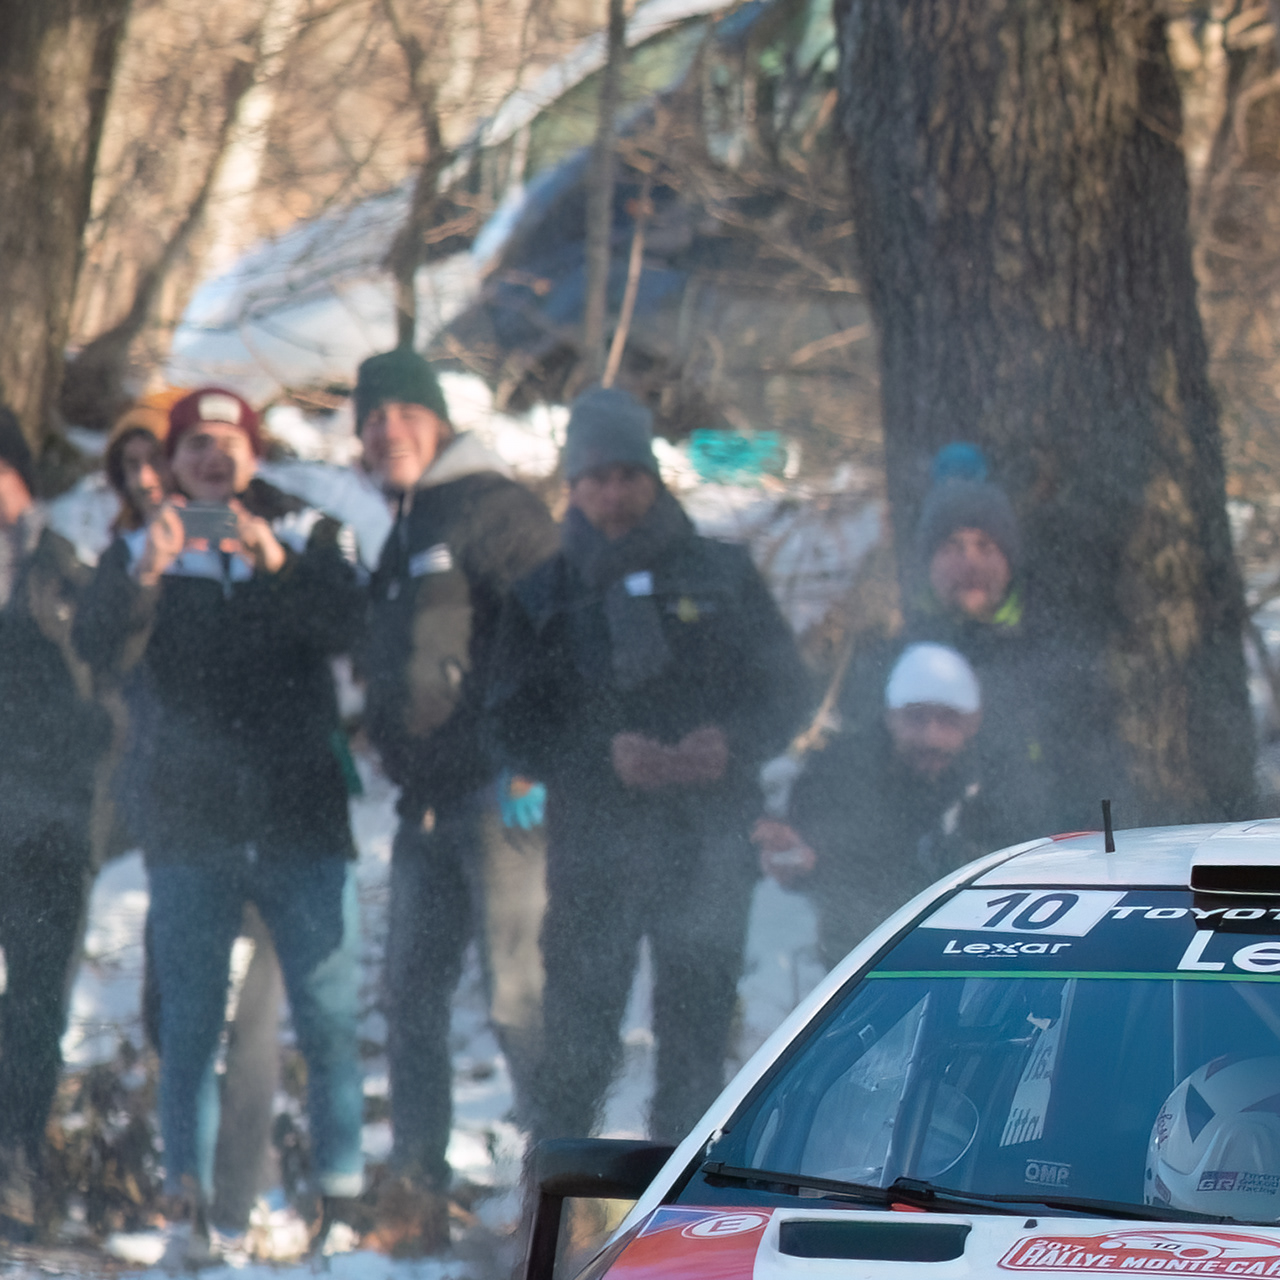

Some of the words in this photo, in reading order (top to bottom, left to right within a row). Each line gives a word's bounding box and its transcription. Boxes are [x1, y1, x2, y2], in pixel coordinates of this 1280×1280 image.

[981, 892, 1079, 931] 10
[943, 940, 1072, 954] Lexar
[1025, 1163, 1070, 1183] OMP
[709, 1218, 747, 1232] E
[1034, 1239, 1084, 1252] 2017
[1019, 1249, 1116, 1269] RALLYE
